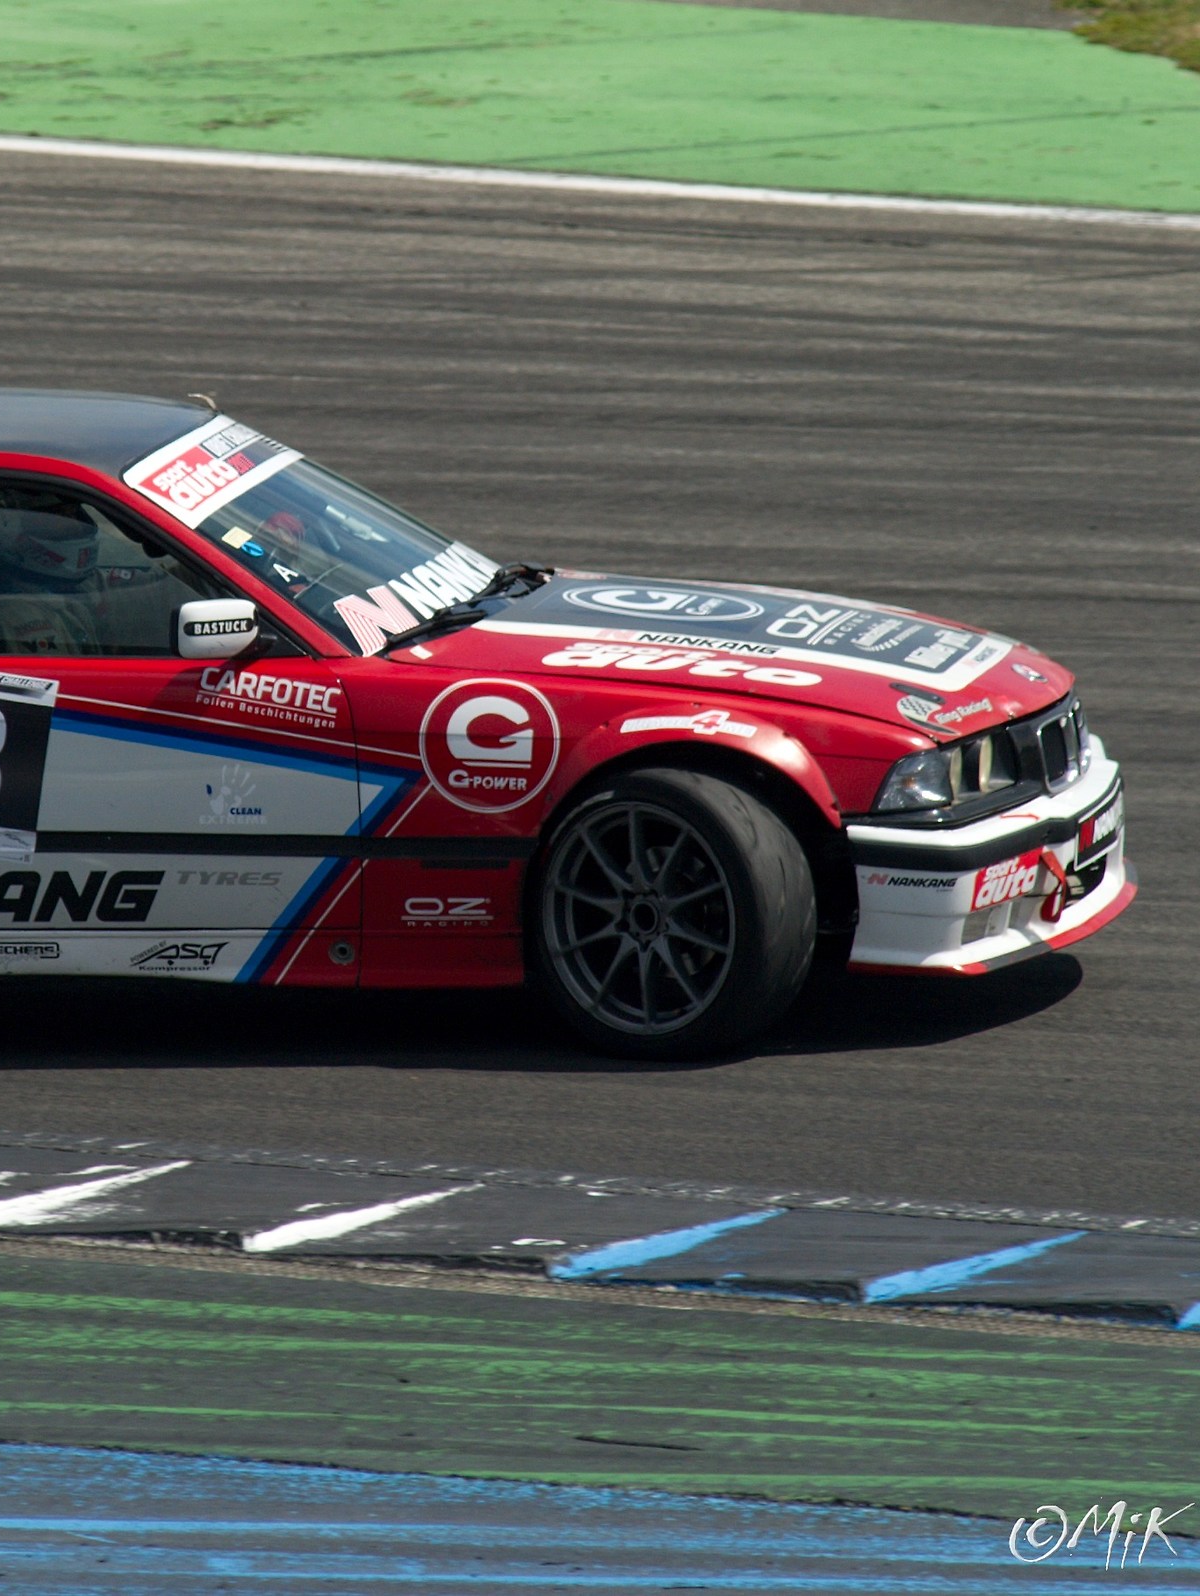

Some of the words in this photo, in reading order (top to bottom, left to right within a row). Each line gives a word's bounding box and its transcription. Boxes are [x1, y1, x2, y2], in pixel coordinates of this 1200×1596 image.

[152, 459, 193, 492] sport
[169, 458, 240, 511] auto
[273, 563, 299, 583] A
[194, 619, 248, 635] BASTUCK
[766, 604, 841, 638] OZ
[637, 633, 782, 656] NANKANG
[541, 649, 823, 687] auto
[200, 667, 341, 714] CARFOTEC
[239, 701, 336, 728] Beschichtungen
[448, 769, 527, 790] G-POWER
[230, 807, 262, 815] CLEAN
[177, 871, 284, 887] TYRES
[984, 857, 1019, 881] sport
[888, 876, 959, 888] NANKANG
[975, 864, 1039, 908] auto
[404, 897, 487, 916] OZ
